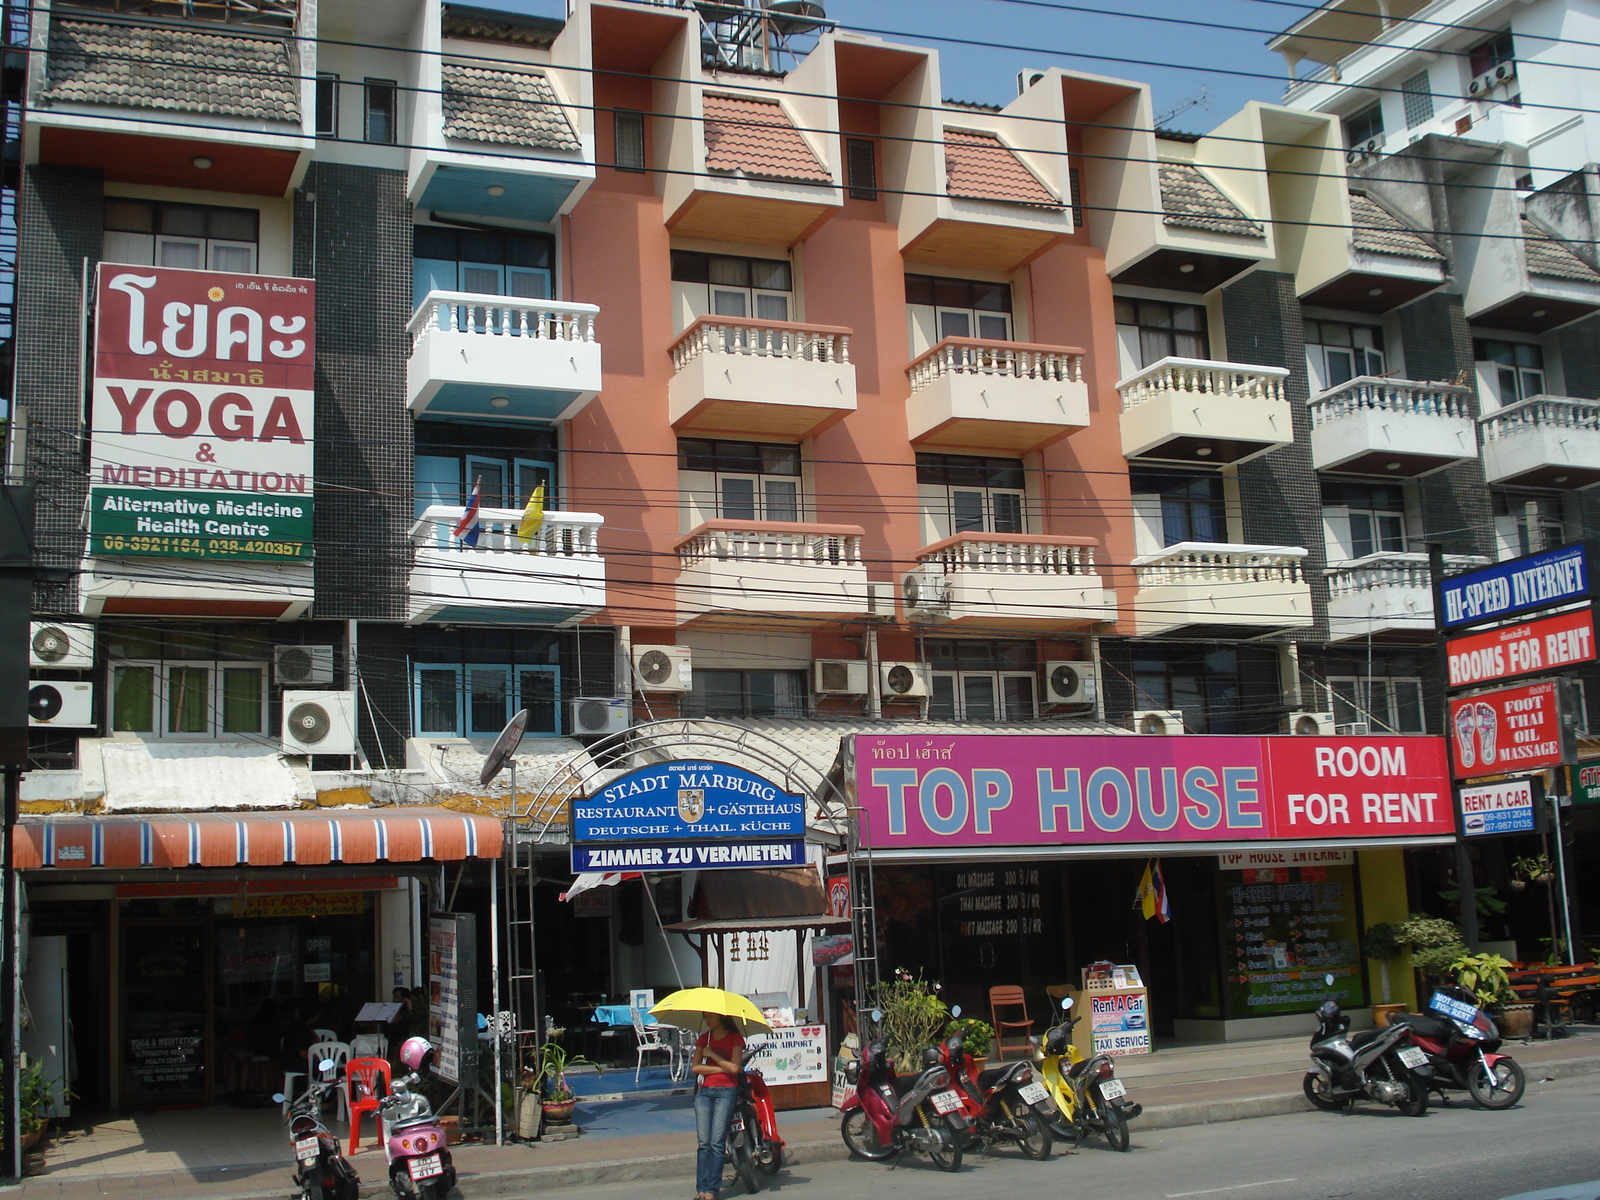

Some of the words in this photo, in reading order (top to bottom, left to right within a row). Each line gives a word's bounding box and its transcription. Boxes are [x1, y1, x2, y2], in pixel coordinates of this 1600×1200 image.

[108, 273, 306, 363] โยคะ
[149, 360, 265, 386] นั่งสมาธิ
[106, 385, 306, 445] YOGA
[195, 442, 217, 463] &
[102, 464, 306, 494] MEDITATION
[103, 495, 210, 515] Alternative
[215, 499, 303, 519] Medicine
[136, 516, 200, 536] Health
[204, 519, 270, 537] Centre
[1445, 576, 1510, 623] HI-SPEED
[1511, 556, 1584, 607] INTERNET
[1448, 645, 1505, 684] ROOMS
[1508, 637, 1542, 673] FOR
[1545, 626, 1591, 666] RENT
[1504, 695, 1544, 715] FOOT
[1506, 711, 1544, 729] THAI
[1514, 728, 1540, 744] OIL
[1500, 740, 1558, 762] MASSAGE
[1315, 746, 1407, 778] ROOM
[604, 775, 670, 803] STADT
[678, 773, 776, 801] MARBURG
[575, 806, 678, 819] RESTAURANT
[717, 802, 802, 816] GÄSTEHAUS
[871, 767, 1013, 836] TOP
[1036, 766, 1263, 833] HOUSE
[1288, 793, 1350, 825] FOR
[1361, 793, 1438, 824] RENT
[1464, 794, 1492, 812] RENT
[1496, 793, 1504, 809] A
[1506, 790, 1529, 807] CAR
[1512, 809, 1532, 819] 2044
[588, 825, 670, 836] DEUTSCHE
[687, 823, 737, 833] THAIL.
[740, 821, 792, 831] KÜCHE
[588, 847, 665, 867] ZIMMER
[668, 846, 693, 864] ZU
[695, 844, 793, 863] VERMIETEN
[956, 873, 967, 889] OIL
[967, 871, 995, 888] MASSAGE
[960, 896, 974, 911] THAI
[975, 895, 1002, 910] MASSAGE
[1007, 894, 1018, 910] 200
[976, 919, 1003, 936] MASSAGE
[1006, 919, 1018, 934] 200
[306, 938, 331, 952] OPEN
[1249, 972, 1291, 983] Translation
[1092, 997, 1115, 1013] Rent
[1117, 996, 1125, 1012] A
[1126, 995, 1143, 1011] Car
[1434, 1002, 1450, 1013] FOR
[1451, 1008, 1472, 1021] RENT
[1435, 993, 1478, 1015] MOTORBIKE
[765, 1031, 783, 1040] TAXI
[785, 1031, 795, 1039] TO
[780, 1040, 813, 1049] AIRPORT
[1094, 1038, 1113, 1050] TAXI
[1115, 1035, 1149, 1048] SERVICE
